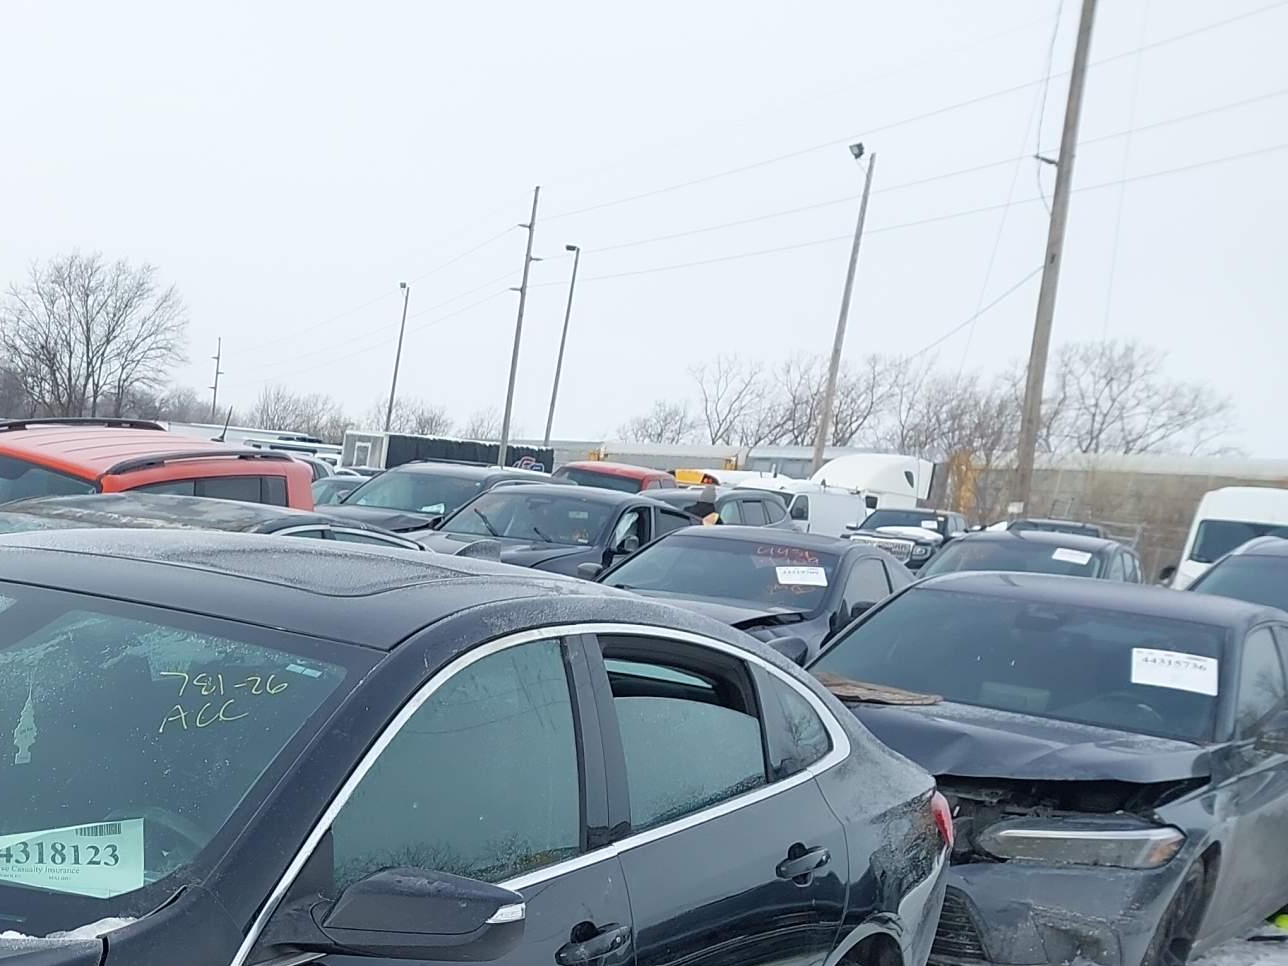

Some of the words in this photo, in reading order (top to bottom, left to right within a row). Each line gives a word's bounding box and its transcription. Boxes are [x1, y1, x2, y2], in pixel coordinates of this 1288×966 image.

[159, 671, 289, 697] 781-26
[158, 699, 250, 734] ACC
[11, 864, 43, 875] Casualty
[44, 866, 81, 875] Insurance
